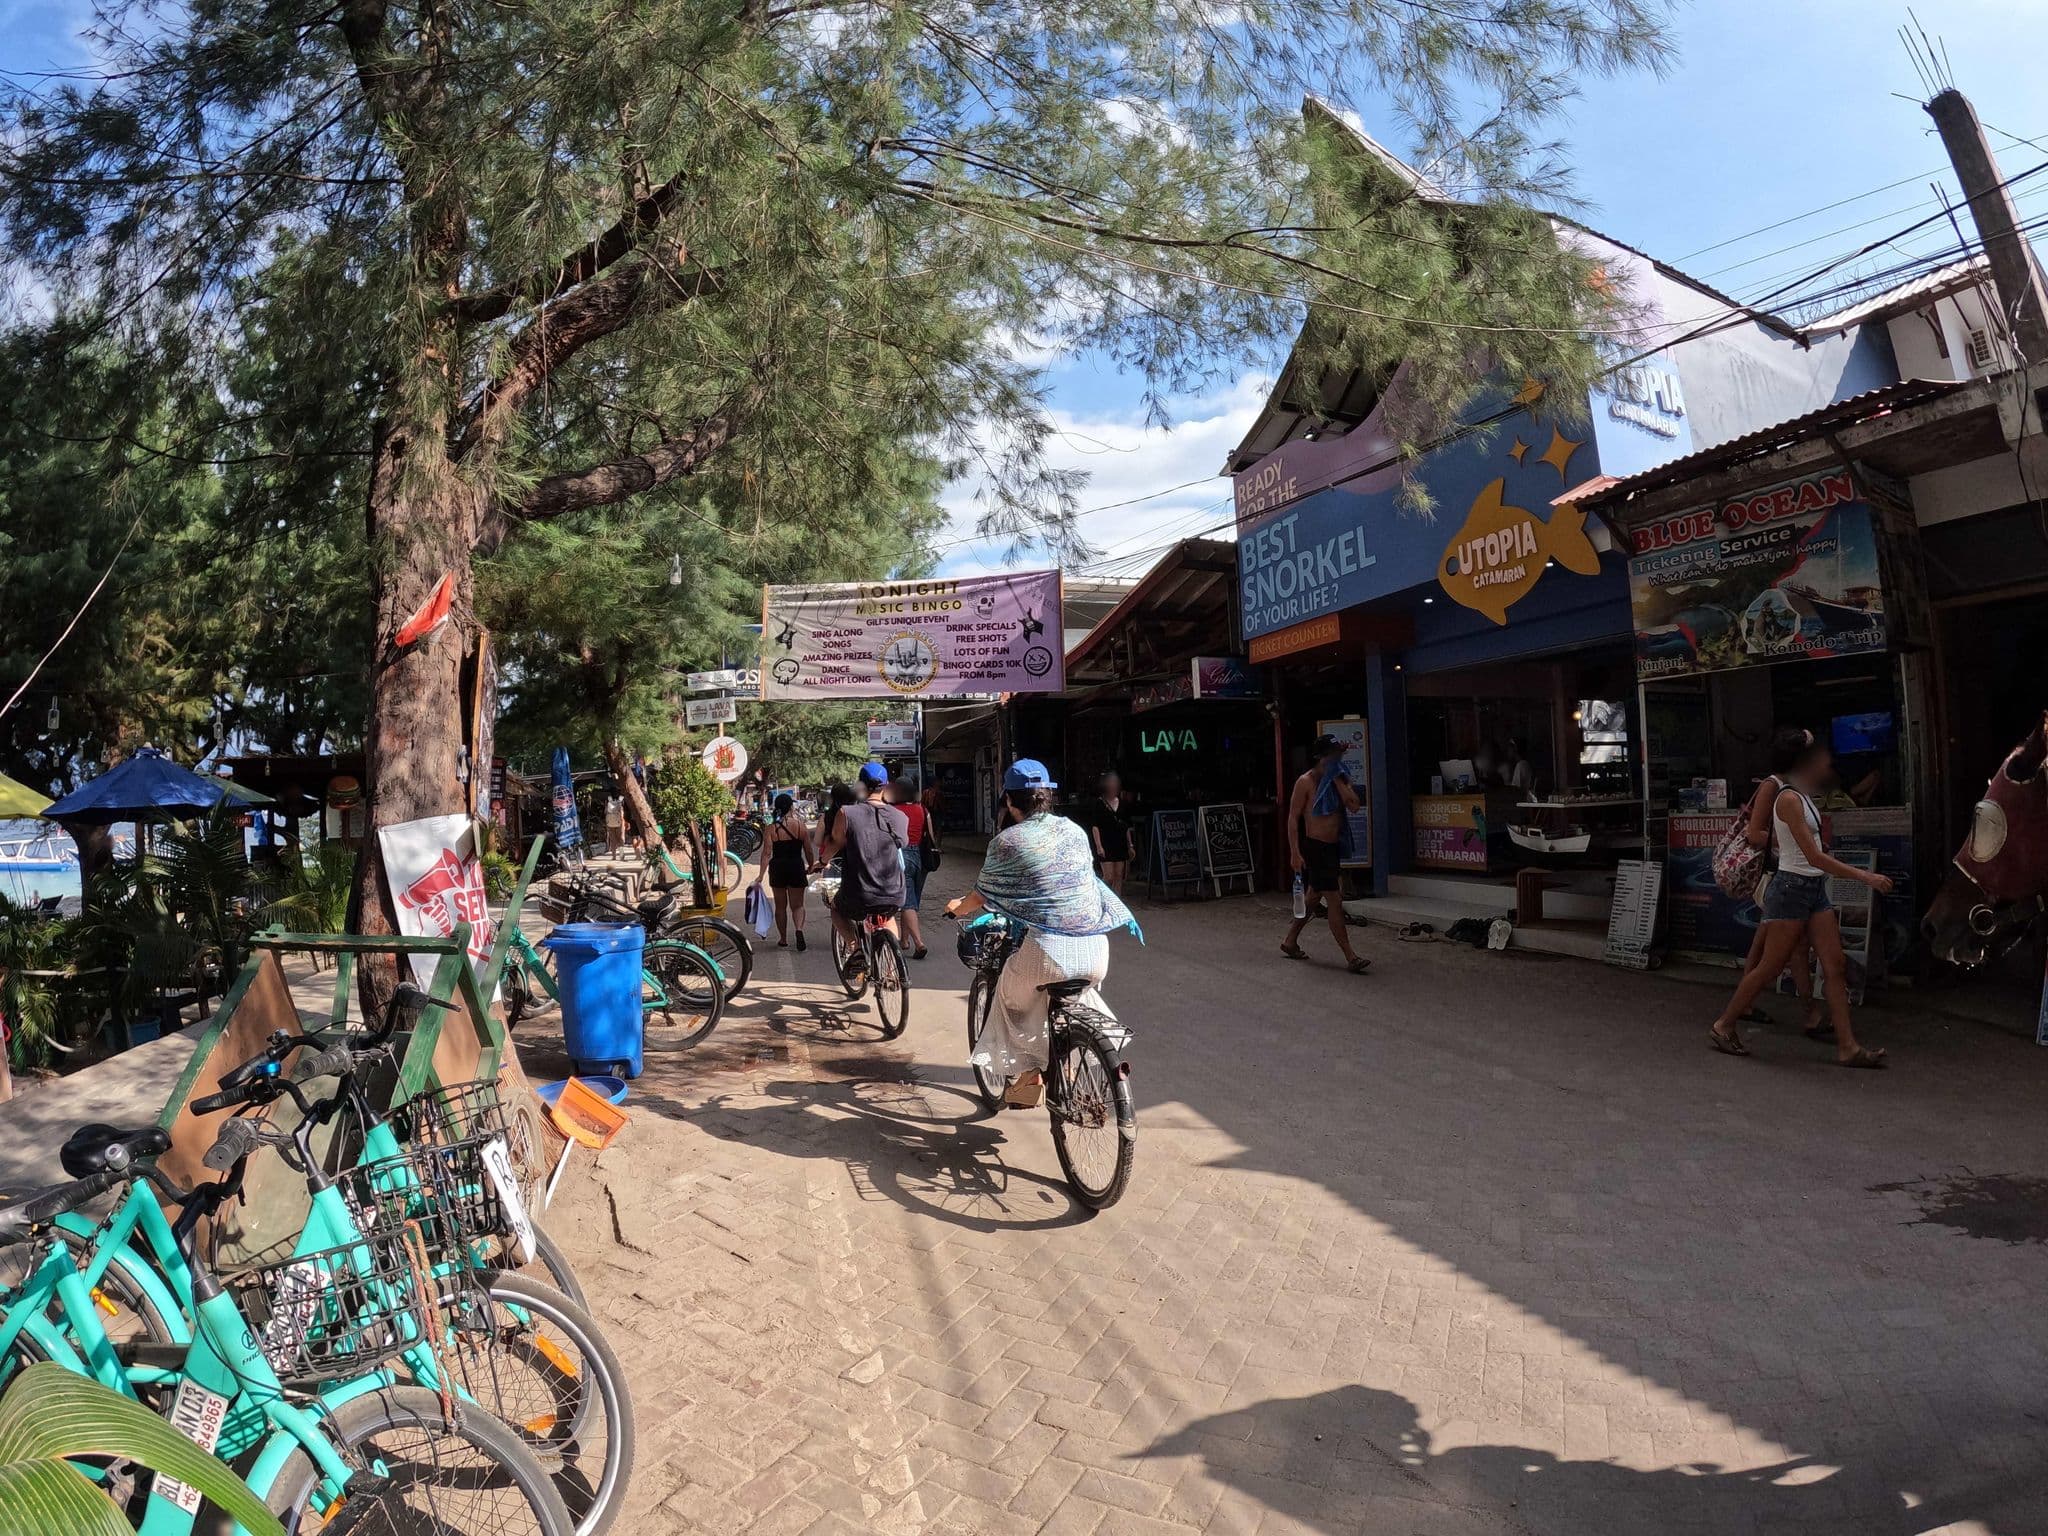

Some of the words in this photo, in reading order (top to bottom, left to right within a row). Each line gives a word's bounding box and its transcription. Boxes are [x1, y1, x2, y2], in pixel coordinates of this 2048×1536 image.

[1237, 457, 1283, 504] READY
[1239, 496, 1265, 528] FOR
[1269, 476, 1299, 507] THE
[1631, 509, 1715, 554] BLUE
[1721, 472, 1855, 530] OCEAN
[1241, 512, 1299, 575] BEST
[1458, 520, 1538, 574] UTOPIA
[1636, 546, 1716, 574] Ticketing
[1719, 528, 1791, 557] Service
[1243, 525, 1376, 612] SNORKEL
[1649, 570, 1681, 587] What
[1681, 567, 1703, 580] can
[1715, 558, 1730, 573] do
[1732, 550, 1766, 569] make
[1767, 548, 1792, 564] you
[1795, 539, 1838, 559] happy
[1473, 564, 1526, 589] CATAMARAN
[858, 581, 960, 599] TONIGHT
[856, 602, 903, 615] MSIC
[912, 600, 962, 611] BINGO
[1245, 611, 1262, 632] OF
[1262, 598, 1300, 626] YOUR
[1298, 586, 1330, 614] LIFE
[891, 616, 922, 626] UNIQUE
[924, 615, 950, 624] EVENT
[946, 624, 973, 632] DRINK
[976, 622, 1016, 631] SPECIALS
[812, 630, 831, 639] SING
[833, 628, 863, 638] ALONG
[956, 635, 976, 643] FREE
[978, 633, 1007, 642] SHOTS
[822, 640, 851, 648] SONGS
[1764, 634, 1836, 657] Komodo
[802, 653, 842, 662] AMAZING
[844, 651, 873, 661] PRIZES
[954, 648, 976, 656] LOTS
[978, 648, 990, 656] OF
[992, 647, 1010, 655] FUN
[822, 665, 850, 674] DANCE
[943, 661, 971, 670] BINGO
[974, 660, 1003, 669] CARDS
[1006, 659, 1022, 668] 10K
[1636, 655, 1684, 673] Rinjani
[803, 678, 818, 686] ALL
[820, 676, 846, 685] NIGHT
[847, 675, 872, 684] LONG
[959, 671, 985, 679] FROM
[709, 701, 730, 710] LAVA
[1431, 830, 1455, 840] THE
[1416, 850, 1485, 863] CATAMARAN
